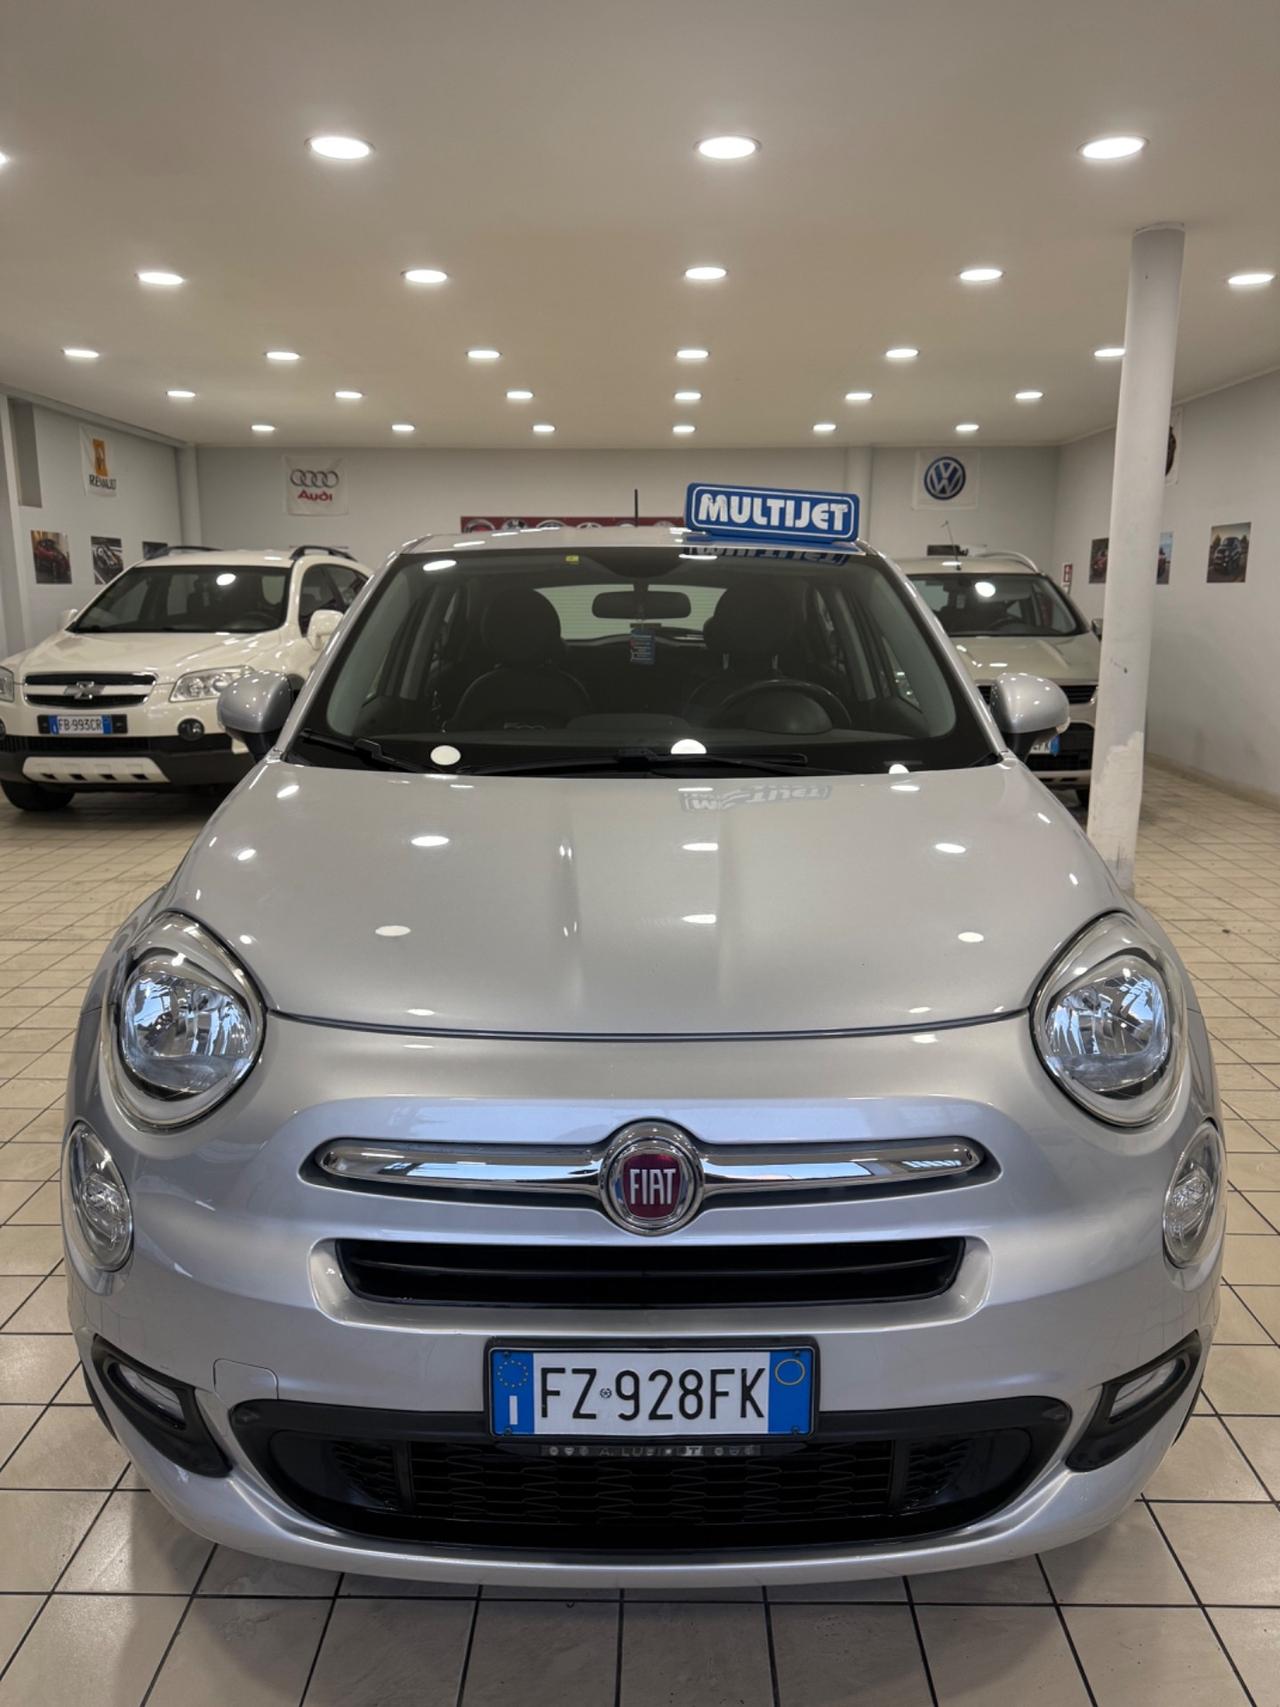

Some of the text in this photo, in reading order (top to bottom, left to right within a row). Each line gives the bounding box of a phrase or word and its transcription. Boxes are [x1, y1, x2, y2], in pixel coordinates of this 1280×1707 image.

[297, 489, 333, 502] Audi
[698, 493, 848, 531] MULTIJET
[629, 1168, 676, 1205] FIAT
